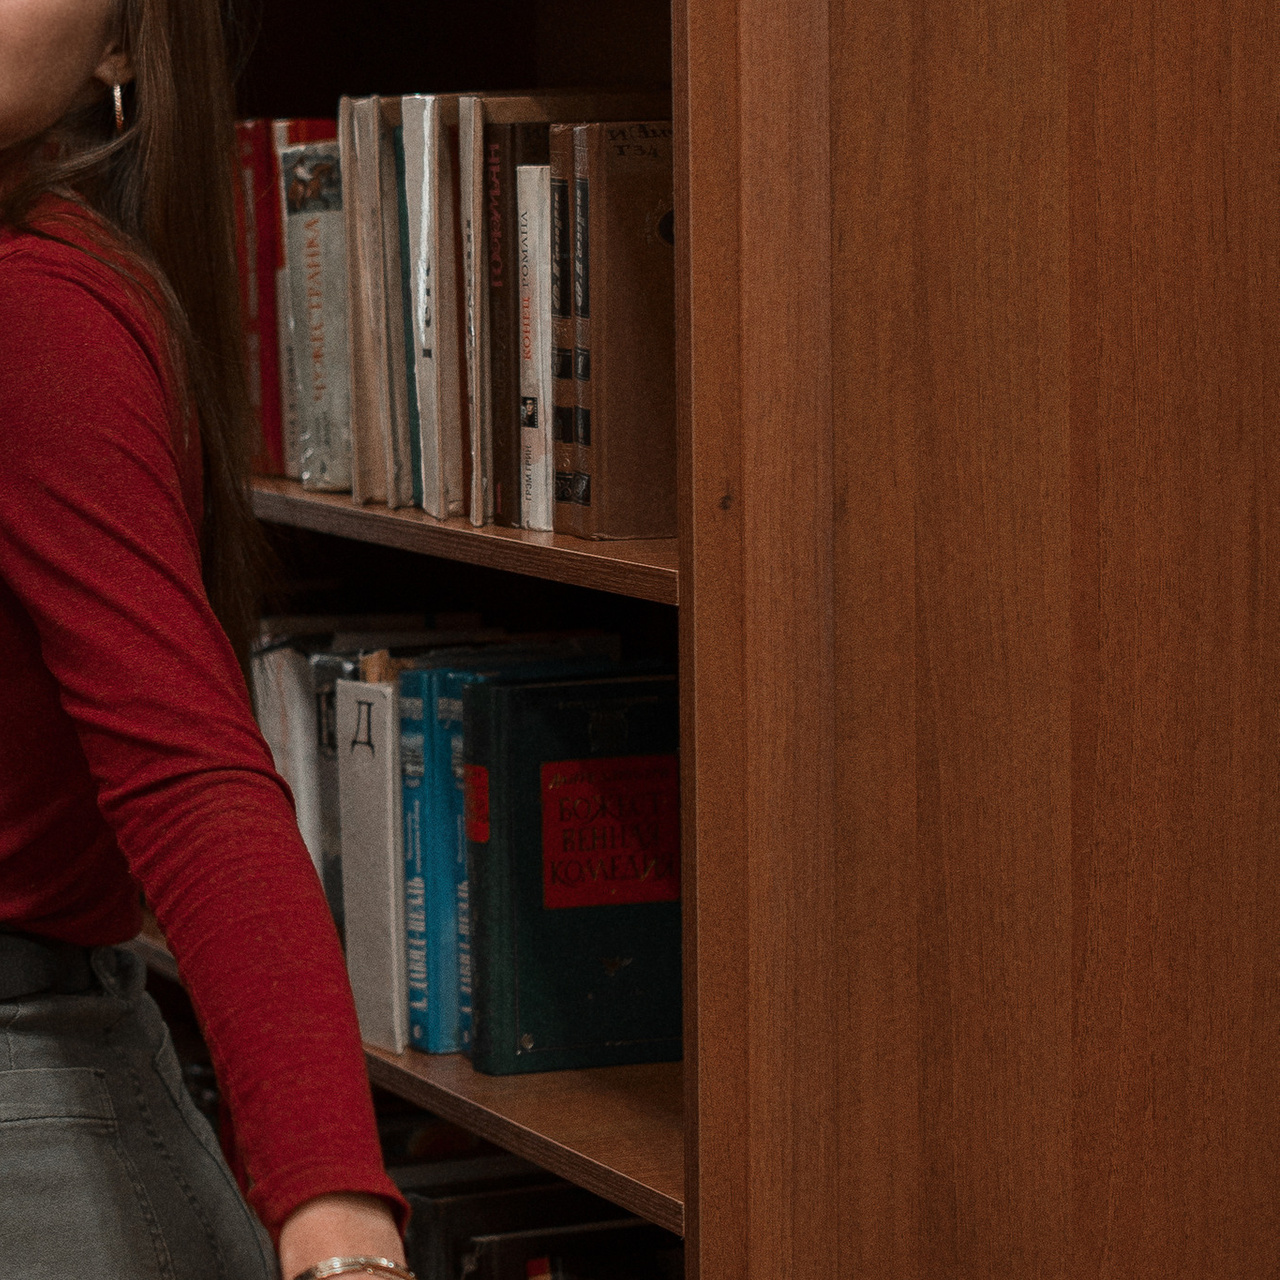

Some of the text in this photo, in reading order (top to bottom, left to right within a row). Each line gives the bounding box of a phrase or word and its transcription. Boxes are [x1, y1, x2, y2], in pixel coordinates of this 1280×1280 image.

[303, 215, 329, 401] ЧУЖЕСТРАНКА
[519, 210, 532, 361] КОНЕЦ РОМАНА
[523, 444, 533, 502] ГРЭМ ГРИН
[351, 699, 376, 759] Д
[562, 823, 661, 853] ВЕННАЯ
[552, 853, 676, 886] КОМЕДИЯ
